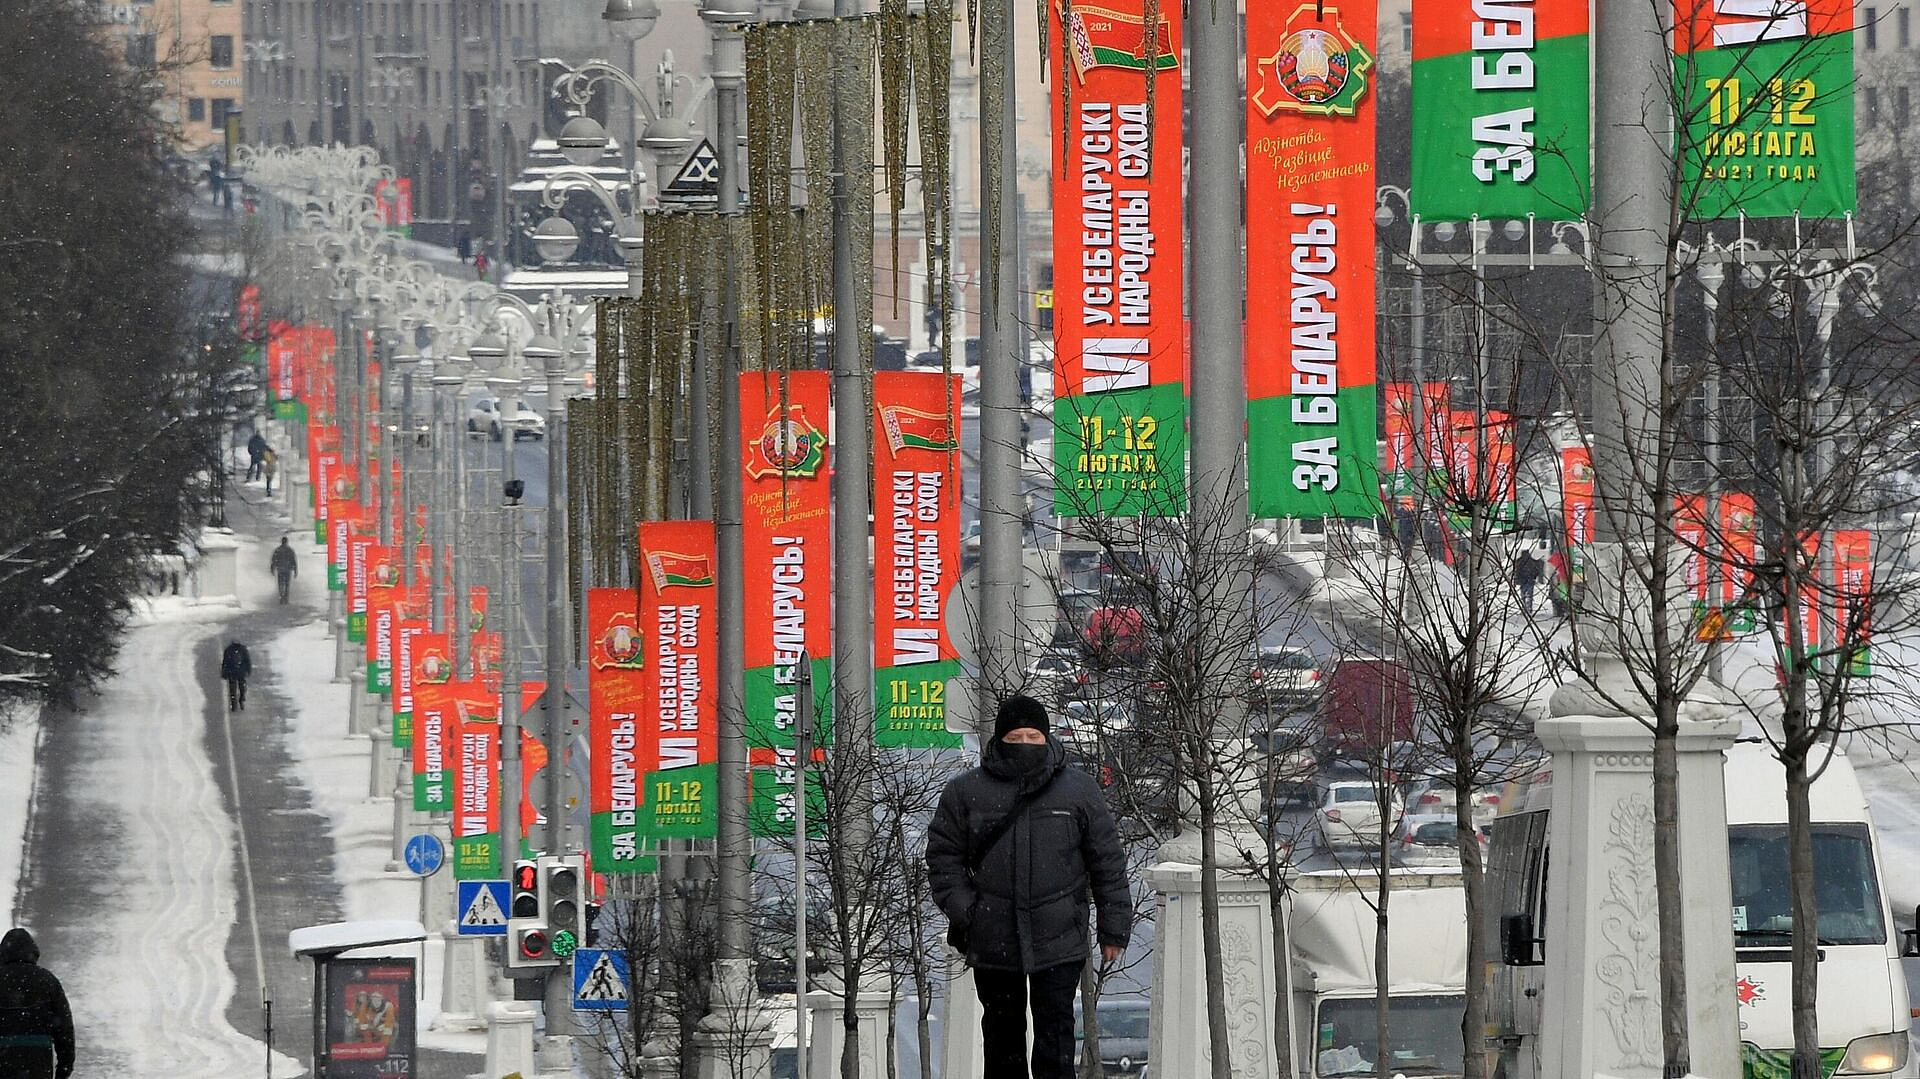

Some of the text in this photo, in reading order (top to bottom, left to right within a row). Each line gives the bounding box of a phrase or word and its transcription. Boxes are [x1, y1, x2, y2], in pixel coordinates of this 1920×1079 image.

[1089, 22, 1112, 31] 2021
[1705, 79, 1816, 124] 11-12
[1253, 128, 1326, 158] Адзінства.
[1274, 146, 1336, 173] Развіццё.
[1472, 107, 1534, 181] ЗА
[1705, 132, 1815, 155] ЛЮТАГА
[1278, 161, 1373, 193] Незалежнасць.
[1704, 165, 1816, 181] 2021 ГОДА
[1081, 103, 1113, 324] УСЕБЕЛАРУСКІ
[1117, 103, 1154, 324] НАРОДНЫ СХОД
[1290, 203, 1338, 492] ЗА БЕЛАРУСЬ!
[1082, 338, 1149, 393] VI
[1078, 415, 1157, 450] 11-12
[1078, 454, 1156, 473] ЛЮТАГА
[893, 471, 915, 620] УСЕБЕЛАРУСКІ
[917, 471, 942, 620] НАРОДНЫ СХОД
[772, 536, 806, 685] БЕЛАРУСЬ!
[893, 628, 940, 666] VI
[658, 605, 677, 731] УСЕБЕЛАРУСКІ
[679, 605, 701, 730] НАРОДНЫ СХОД
[890, 680, 944, 704] 11-12
[890, 705, 944, 719] ЛЮТАГА
[424, 711, 443, 782] БЕЛАРУСЬ!
[658, 737, 698, 770] VI
[462, 733, 475, 813] УСЕБЕЛАРУСКІ
[611, 713, 636, 827] БЕЛАРУСЬ!
[426, 784, 443, 803] ЗА
[656, 781, 702, 801] 11-12
[462, 816, 488, 837] VI
[461, 843, 490, 856] 11-12
[612, 831, 636, 861] ЗА
[385, 1059, 408, 1073] 112
